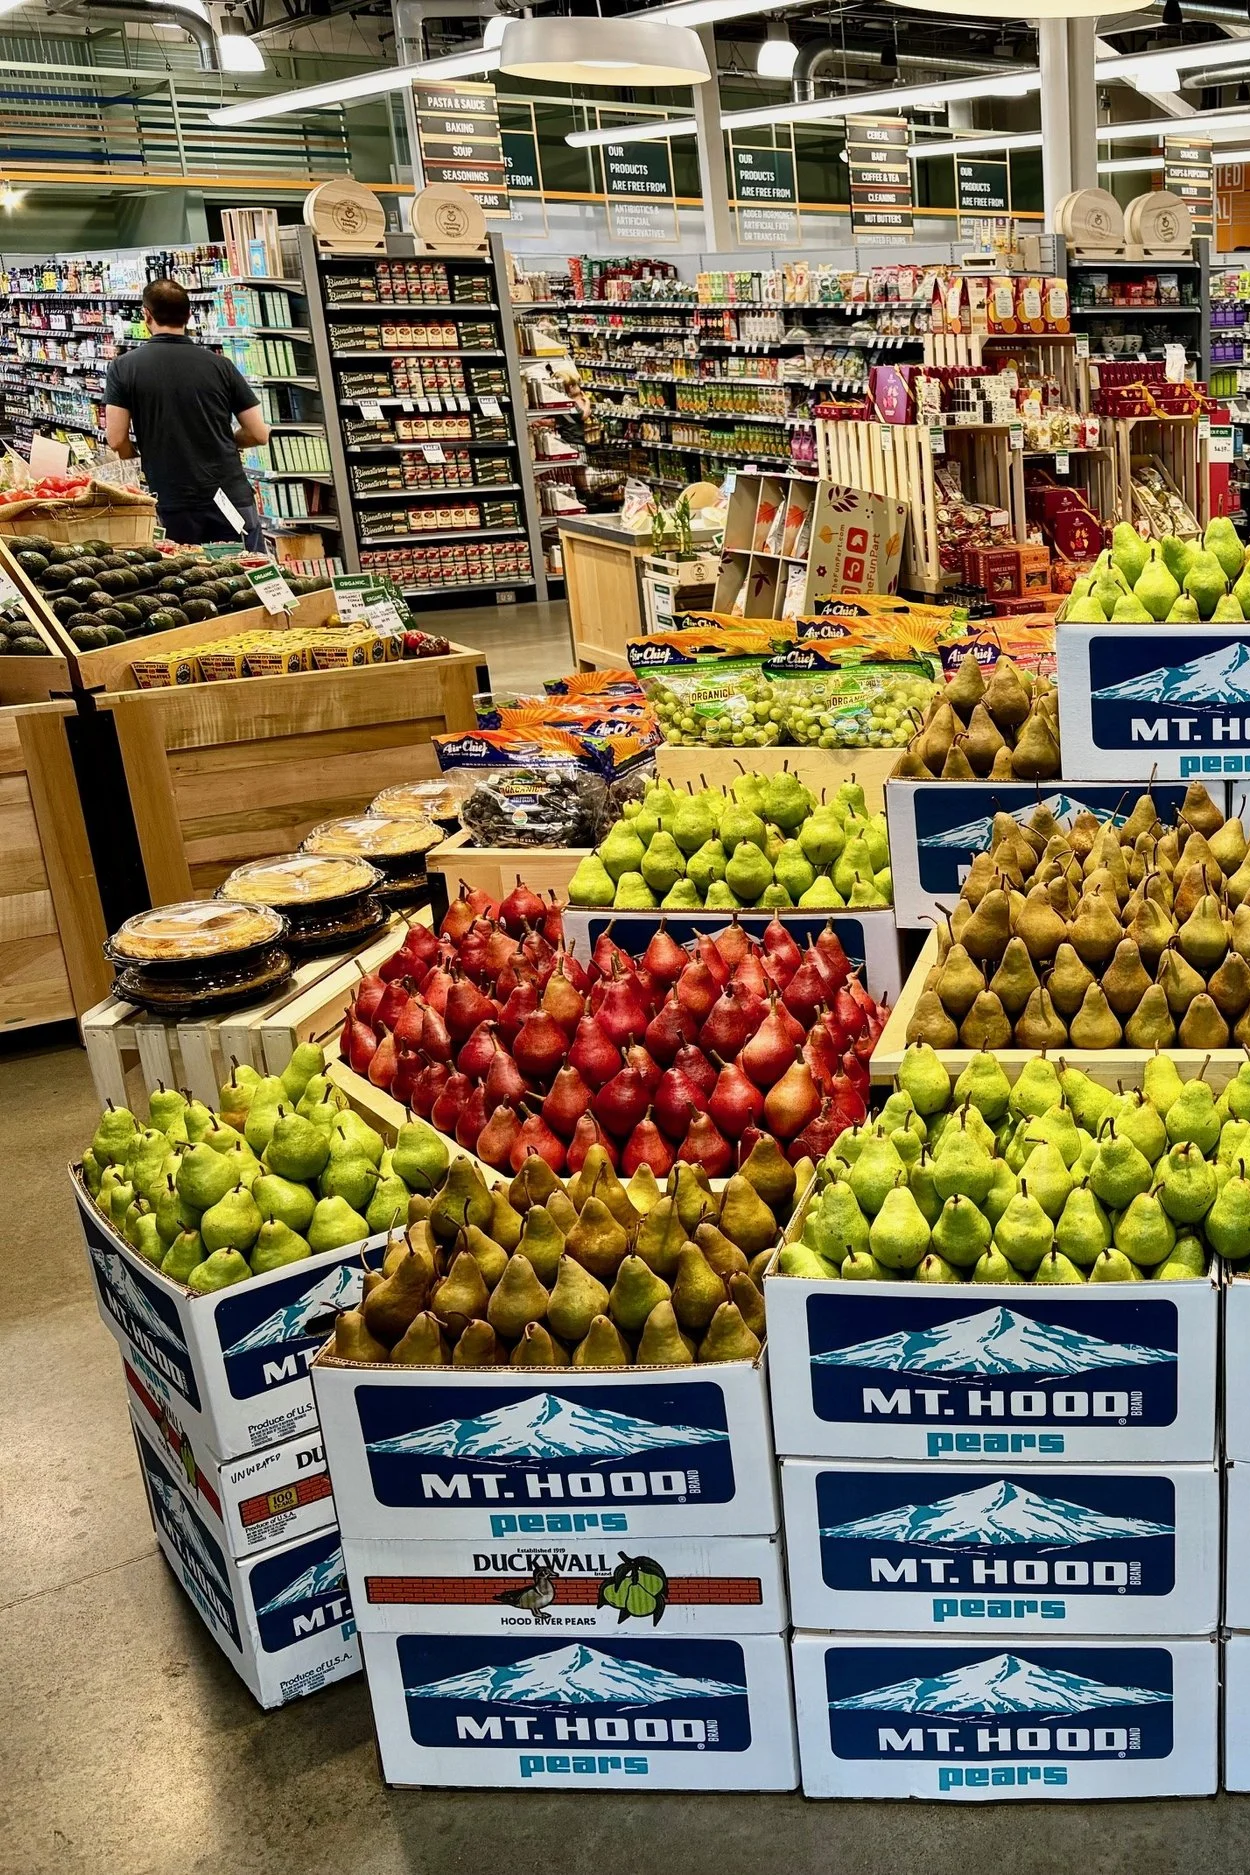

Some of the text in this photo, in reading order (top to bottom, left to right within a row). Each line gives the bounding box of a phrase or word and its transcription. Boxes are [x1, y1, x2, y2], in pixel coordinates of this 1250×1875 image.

[428, 96, 486, 111] PASTA SAUCE
[446, 122, 474, 134] BAKING
[453, 146, 473, 157] SOUP
[608, 146, 624, 157] OUR
[871, 152, 888, 162] BABY
[739, 154, 753, 164] OUR
[442, 170, 489, 182] SEASONINGS
[610, 163, 648, 175] PRODUCTS
[740, 170, 775, 181] PRODUCTS
[960, 167, 973, 176] OUR
[511, 174, 533, 186] FROM
[861, 173, 899, 183] COFFEE TEA
[612, 180, 666, 193] ARE FREE FROM
[741, 187, 791, 198] ARE FREE FROM
[961, 182, 990, 192] PRODUCTS
[475, 194, 498, 206] BEANS
[868, 193, 896, 203] CLEANING
[962, 197, 1004, 207] ARE FREE FROM
[864, 214, 902, 224] NUT BUTTERS
[830, 523, 846, 593] TheFunPart.com
[254, 571, 273, 580] ORGANIC
[804, 626, 845, 639] Air Chief
[646, 646, 673, 664] Chief
[787, 651, 817, 668] Chief
[691, 689, 729, 701] ORGANIC
[1131, 717, 1201, 741] MT.
[443, 740, 490, 757] Air Chief
[134, 1322, 186, 1392] HOOD
[863, 1388, 1142, 1417] MT. HOOD BRAND
[248, 1415, 284, 1434] Produce
[286, 1409, 296, 1422] of
[927, 1432, 1064, 1456] pears
[421, 1470, 698, 1499] MT. HOOD BRAND
[273, 1490, 292, 1504] 100
[245, 1512, 296, 1533] Produce U.S.A.
[489, 1513, 627, 1537] pears
[474, 1554, 611, 1573] DUCKWALL
[870, 1559, 1141, 1586] MT. HOOD BRAND
[293, 1597, 351, 1636] MT.
[933, 1599, 1066, 1622] pears
[501, 1617, 596, 1626] HOOD RIVER PEARS
[280, 1669, 314, 1689] Produce
[325, 1653, 352, 1670] U.S.A.
[456, 1717, 718, 1743] MT. HOOD BRAND
[878, 1728, 1141, 1752] MT. HOOD BRAND
[520, 1755, 648, 1777] pears
[939, 1767, 1068, 1791] pears
